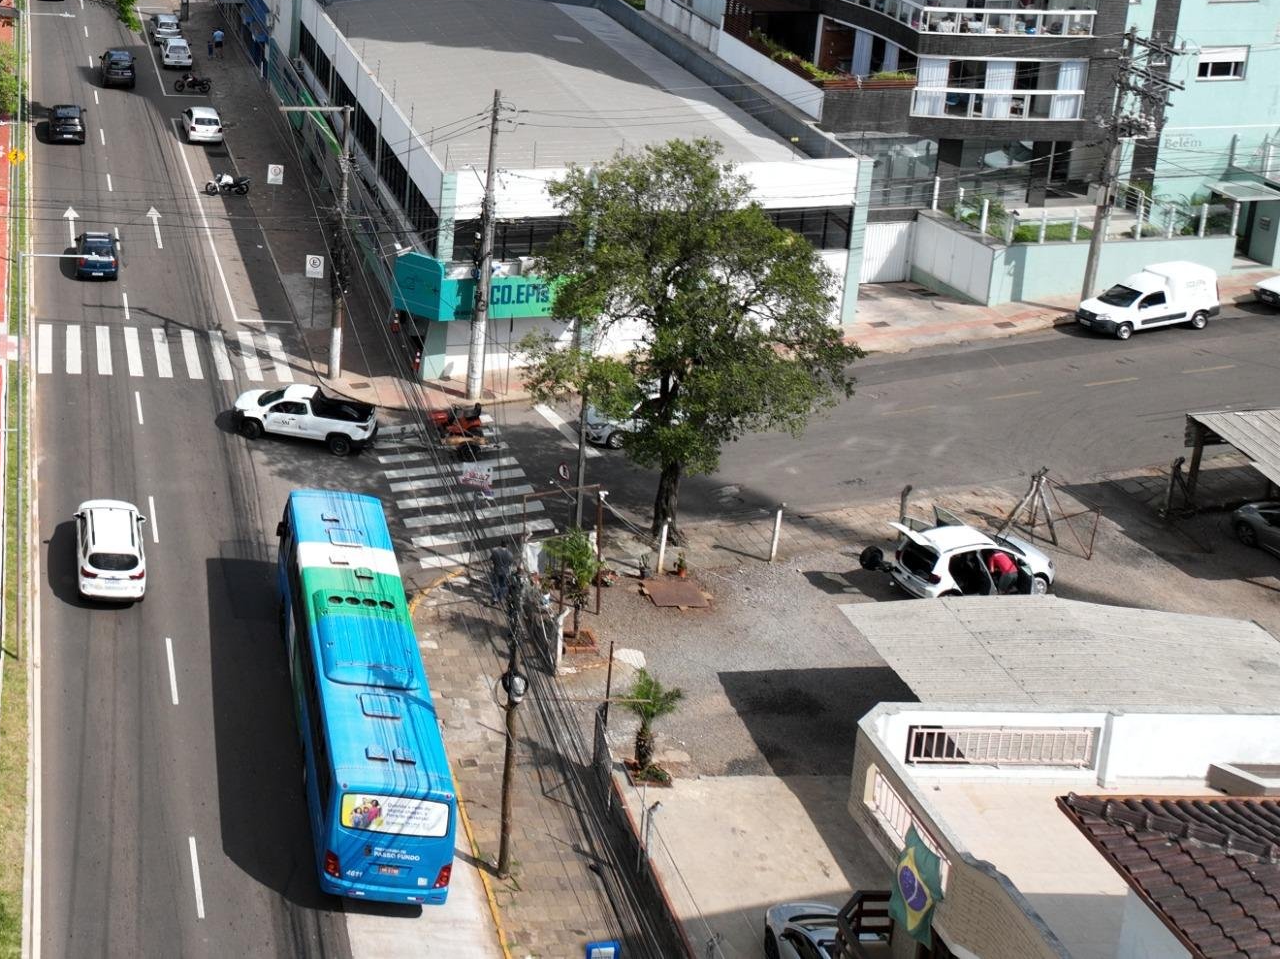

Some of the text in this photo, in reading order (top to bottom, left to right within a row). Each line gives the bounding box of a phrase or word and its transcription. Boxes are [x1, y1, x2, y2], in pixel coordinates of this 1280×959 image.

[1164, 136, 1202, 148] Belém
[373, 850, 421, 861] PASSO FUNDO
